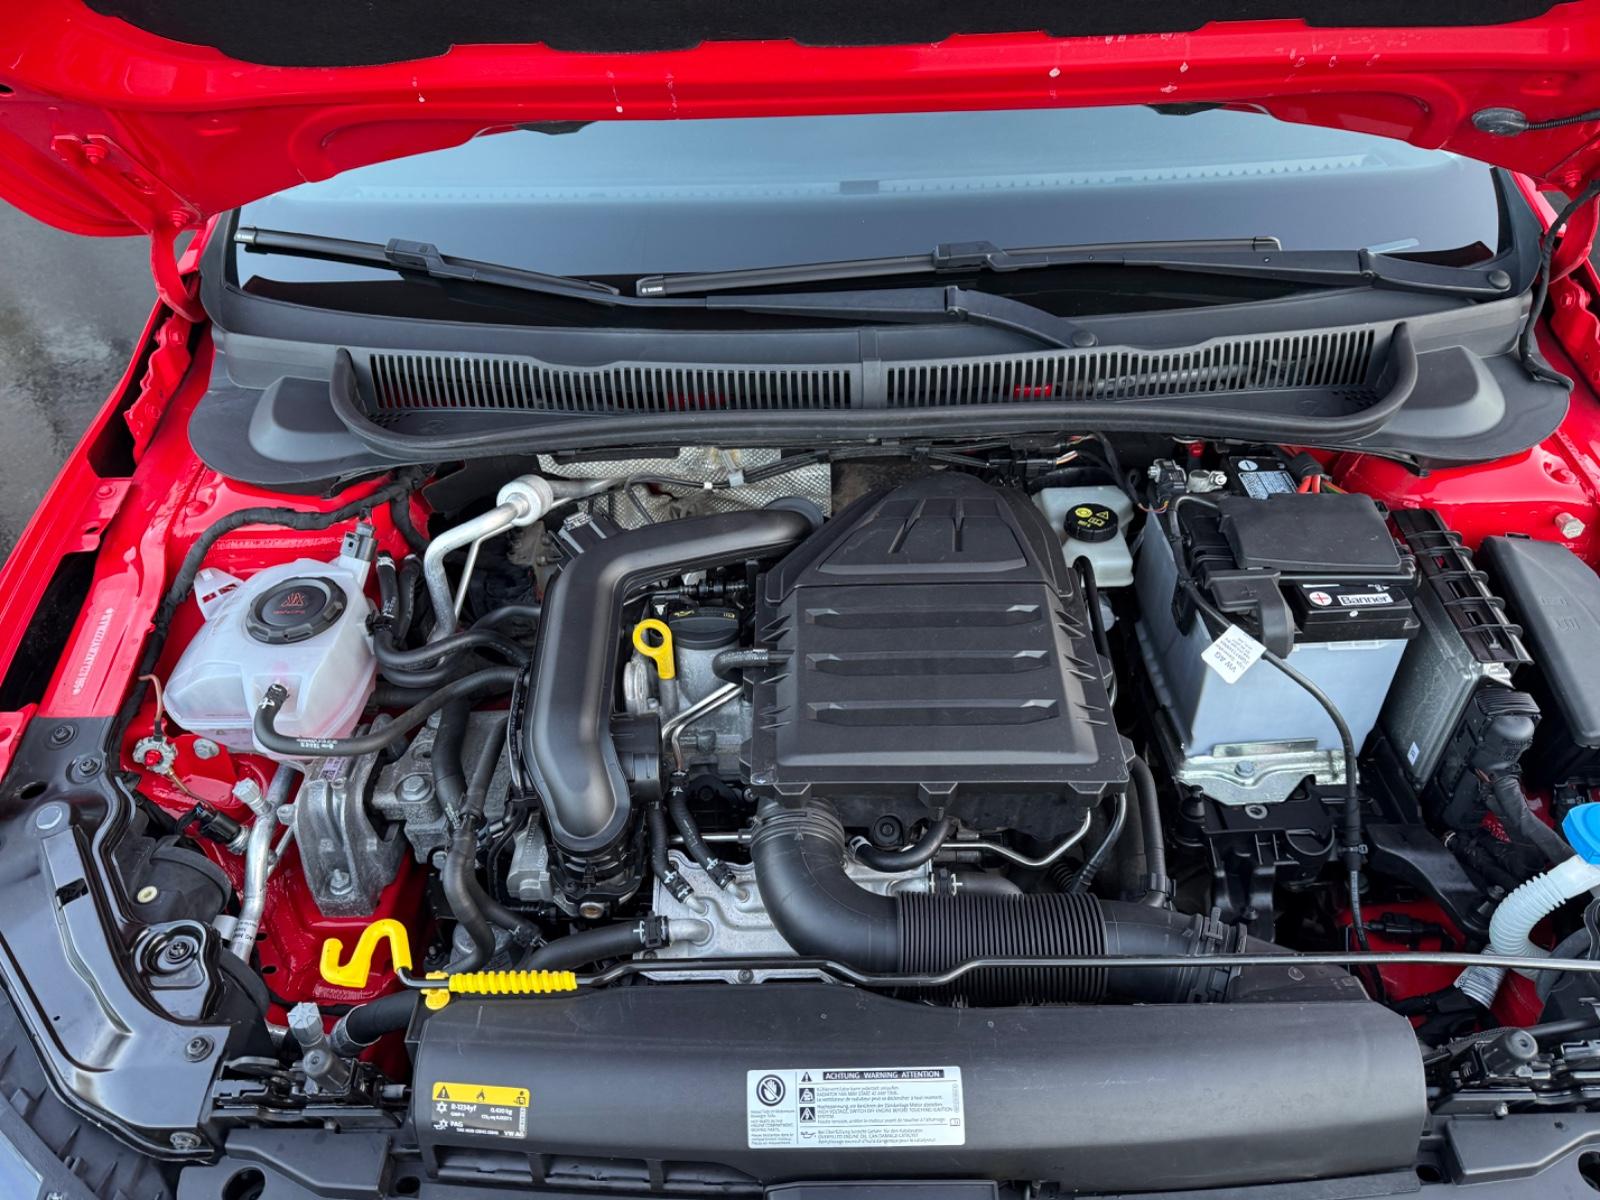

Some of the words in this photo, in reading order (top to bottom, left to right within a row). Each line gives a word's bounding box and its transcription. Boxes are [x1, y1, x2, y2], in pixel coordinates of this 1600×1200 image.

[1341, 595, 1389, 604] Banner
[825, 1071, 861, 1080] ACHTUNG
[863, 1070, 899, 1079] WARNING
[901, 1069, 940, 1079] ATTENTION
